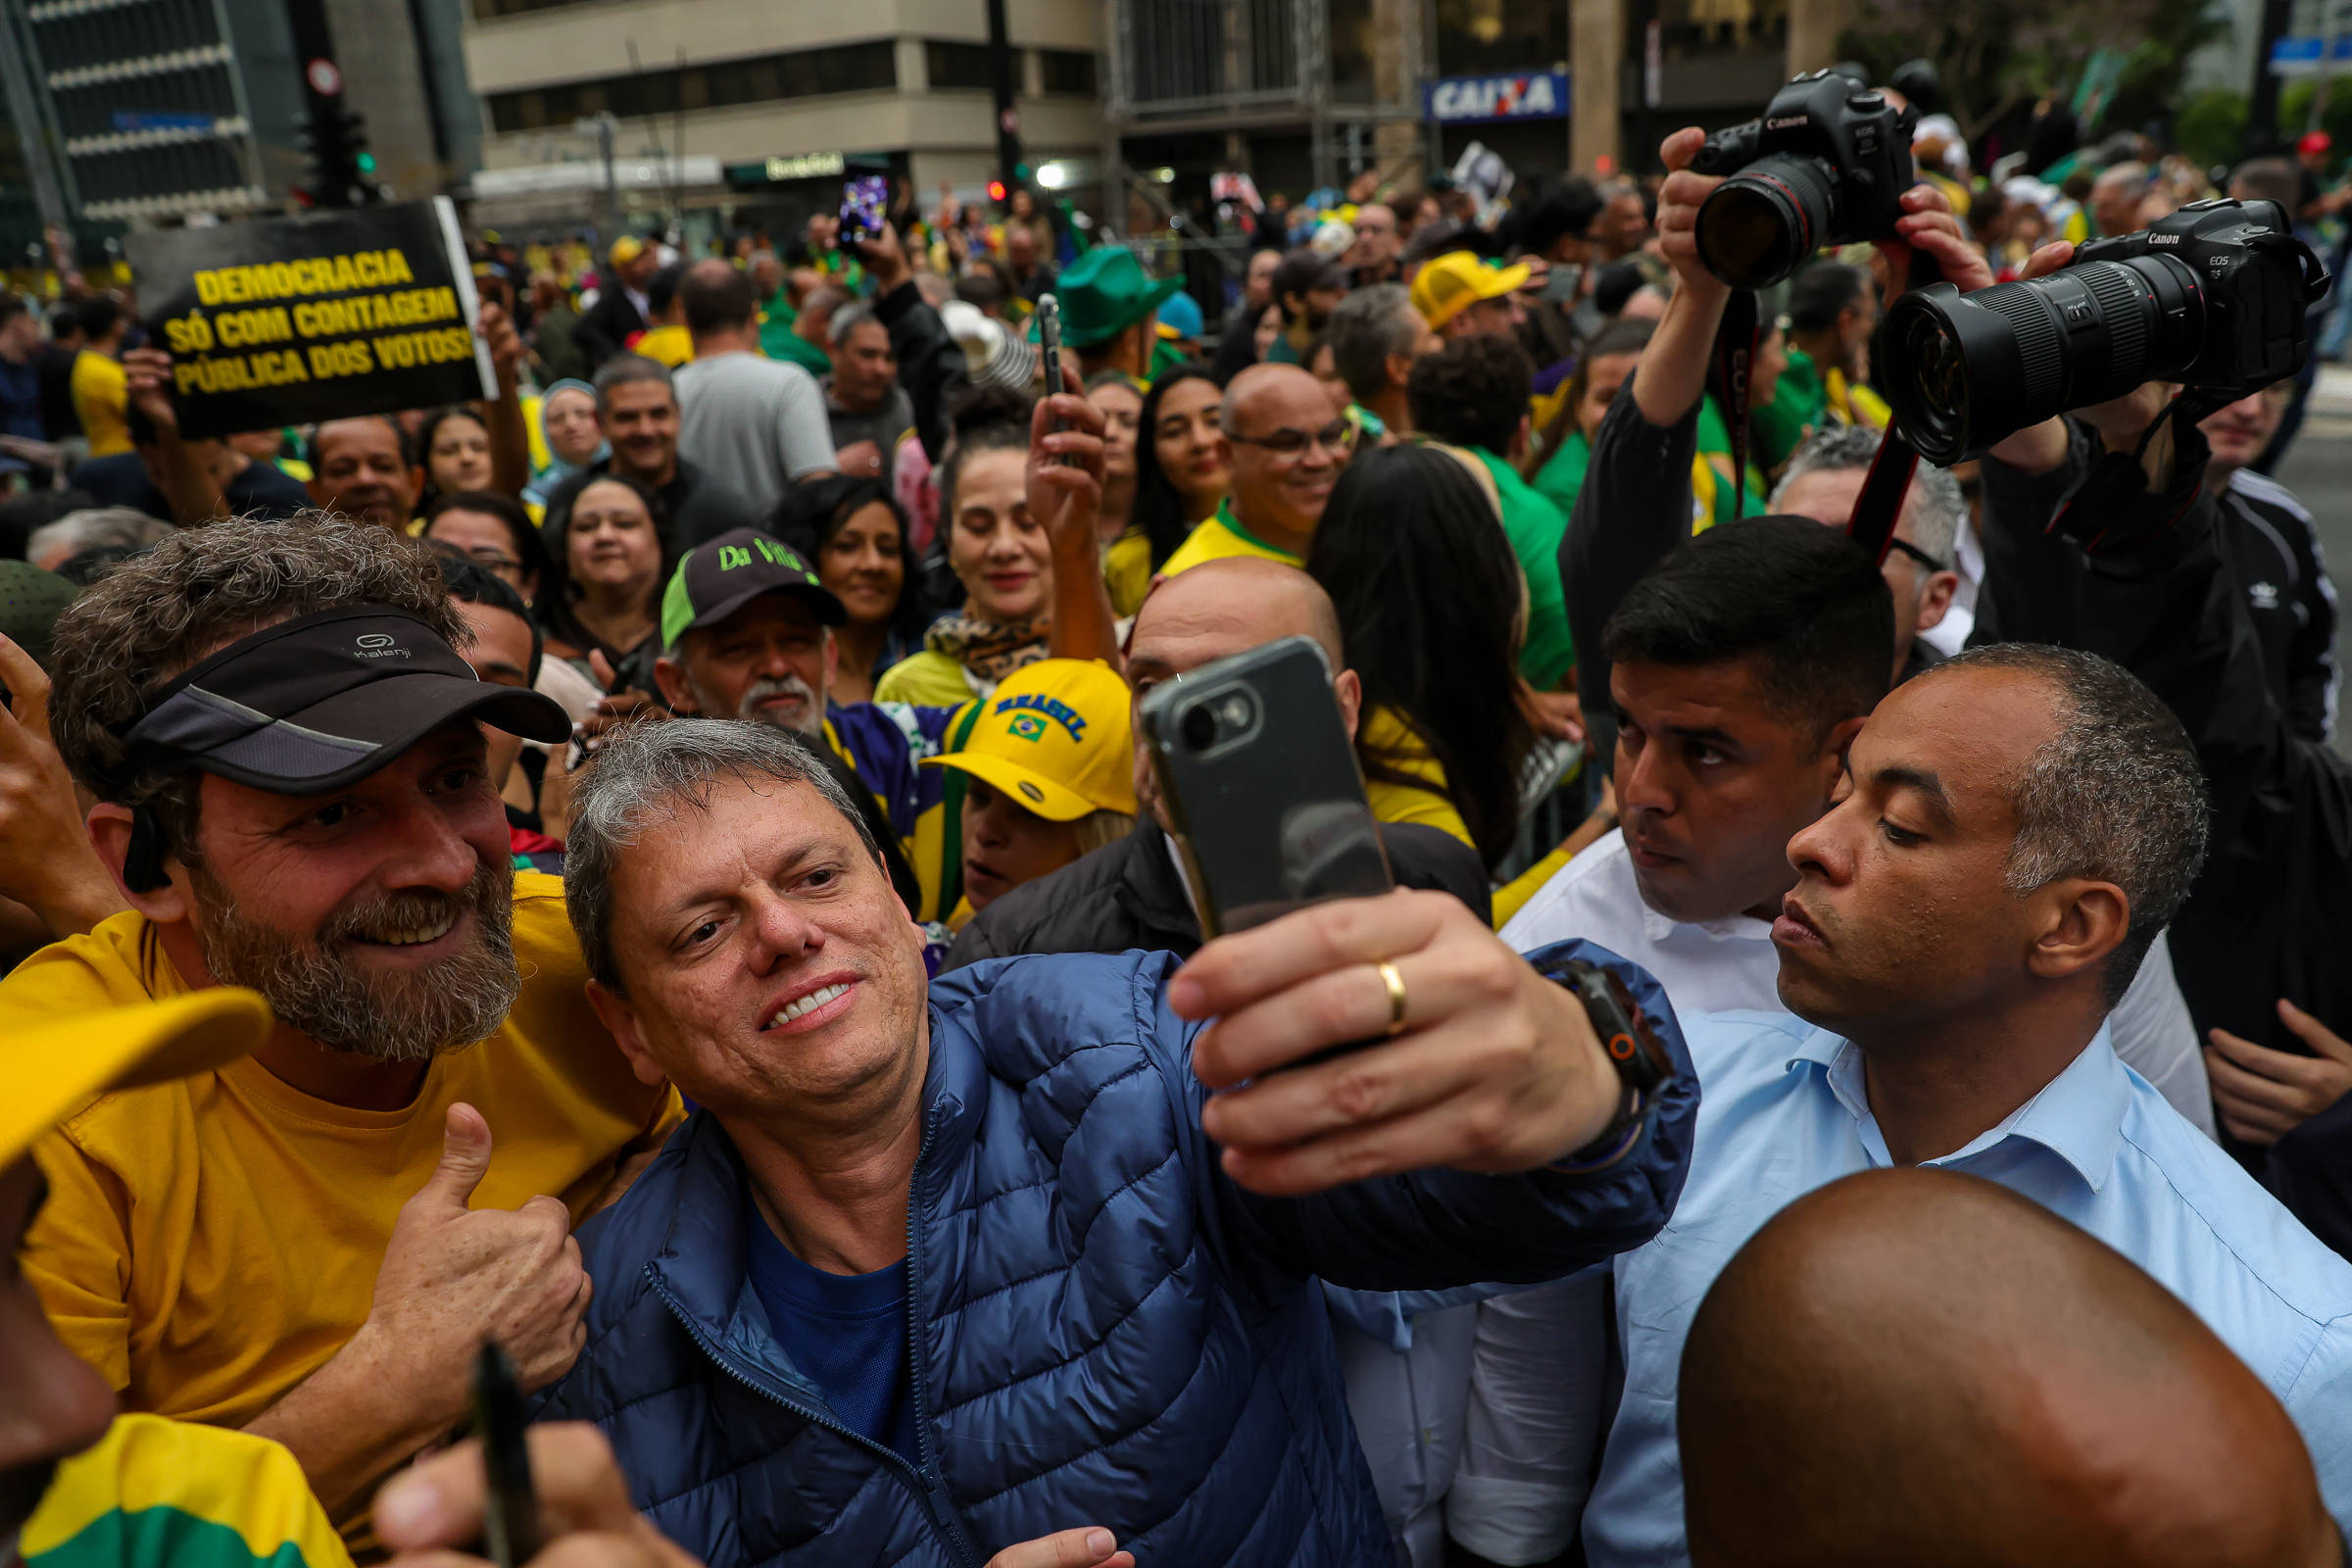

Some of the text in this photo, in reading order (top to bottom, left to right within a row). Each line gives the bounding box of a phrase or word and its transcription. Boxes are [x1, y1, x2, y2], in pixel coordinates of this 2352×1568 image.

[1432, 74, 1556, 119] CAIXA
[1767, 116, 1808, 130] Canon
[2148, 232, 2180, 245] Canon
[194, 248, 414, 306] DEMOCRACIA
[2210, 256, 2230, 266] EOS
[165, 285, 458, 354] SÓ COM CONTAGEM
[173, 352, 309, 395] PÚBLICA
[308, 339, 374, 379] DOS
[718, 545, 752, 571] Da
[354, 648, 412, 659] Kalenji
[994, 694, 1087, 744] BRASIL
